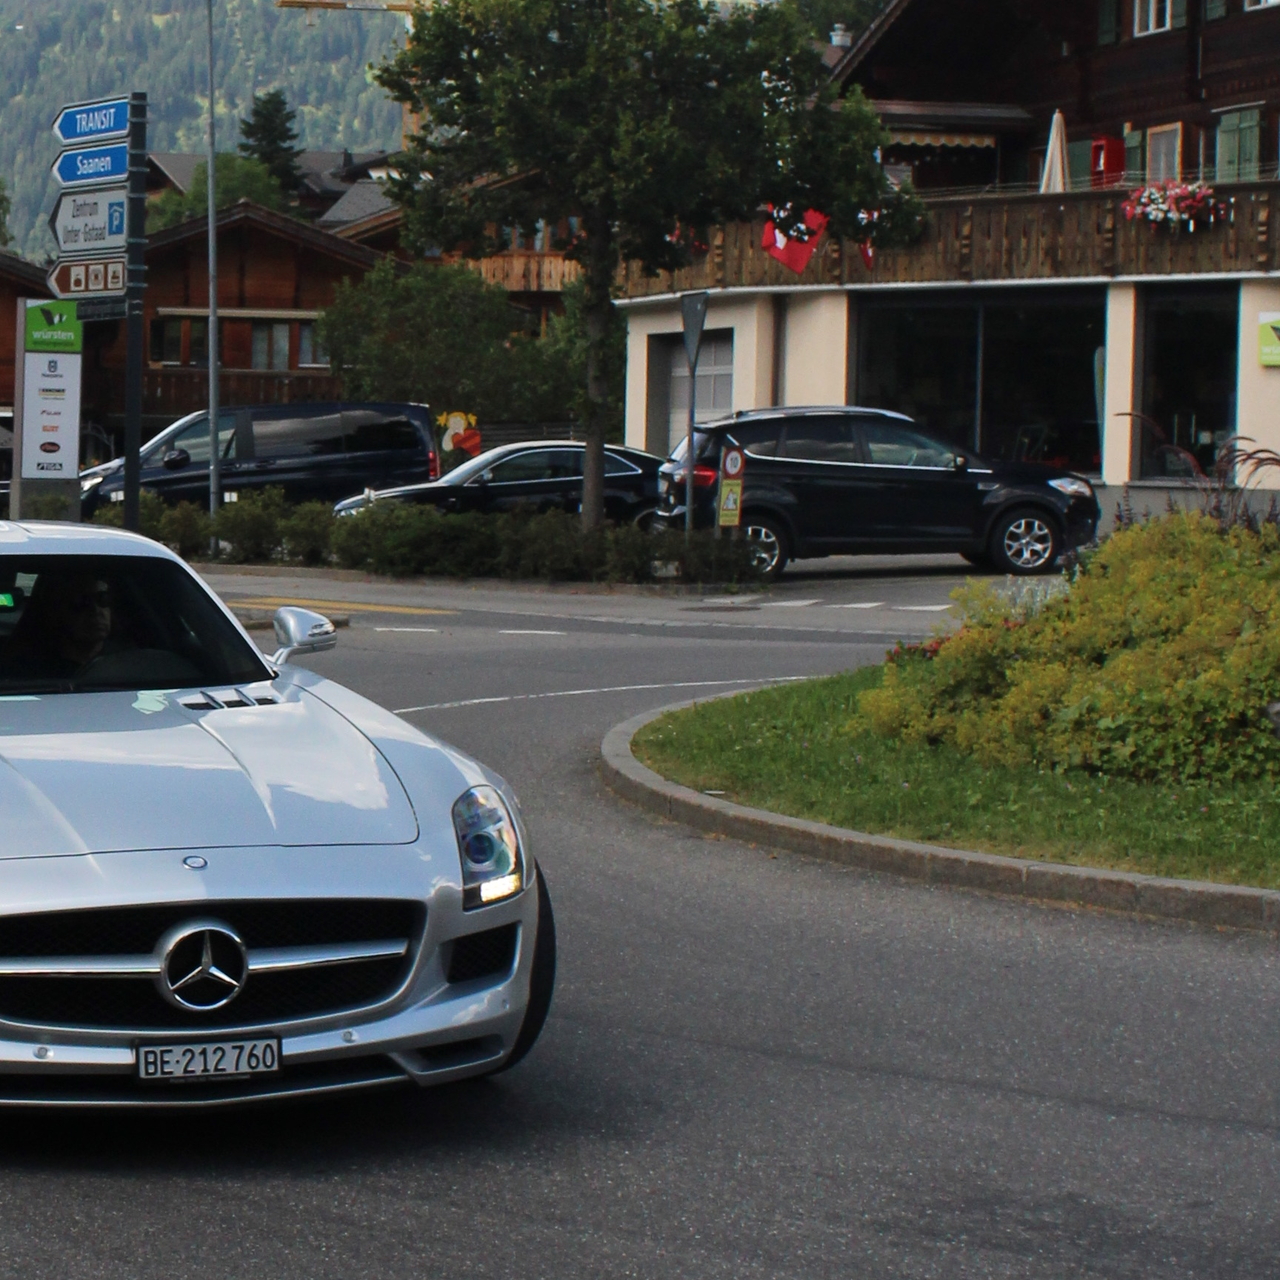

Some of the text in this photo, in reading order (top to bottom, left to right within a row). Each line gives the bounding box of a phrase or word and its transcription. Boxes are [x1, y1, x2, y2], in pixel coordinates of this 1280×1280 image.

[76, 108, 116, 133] TRANSIT
[76, 156, 111, 175] Saanen
[72, 199, 98, 218] Zentrum
[32, 329, 74, 340] würsten
[730, 456, 739, 469] 10
